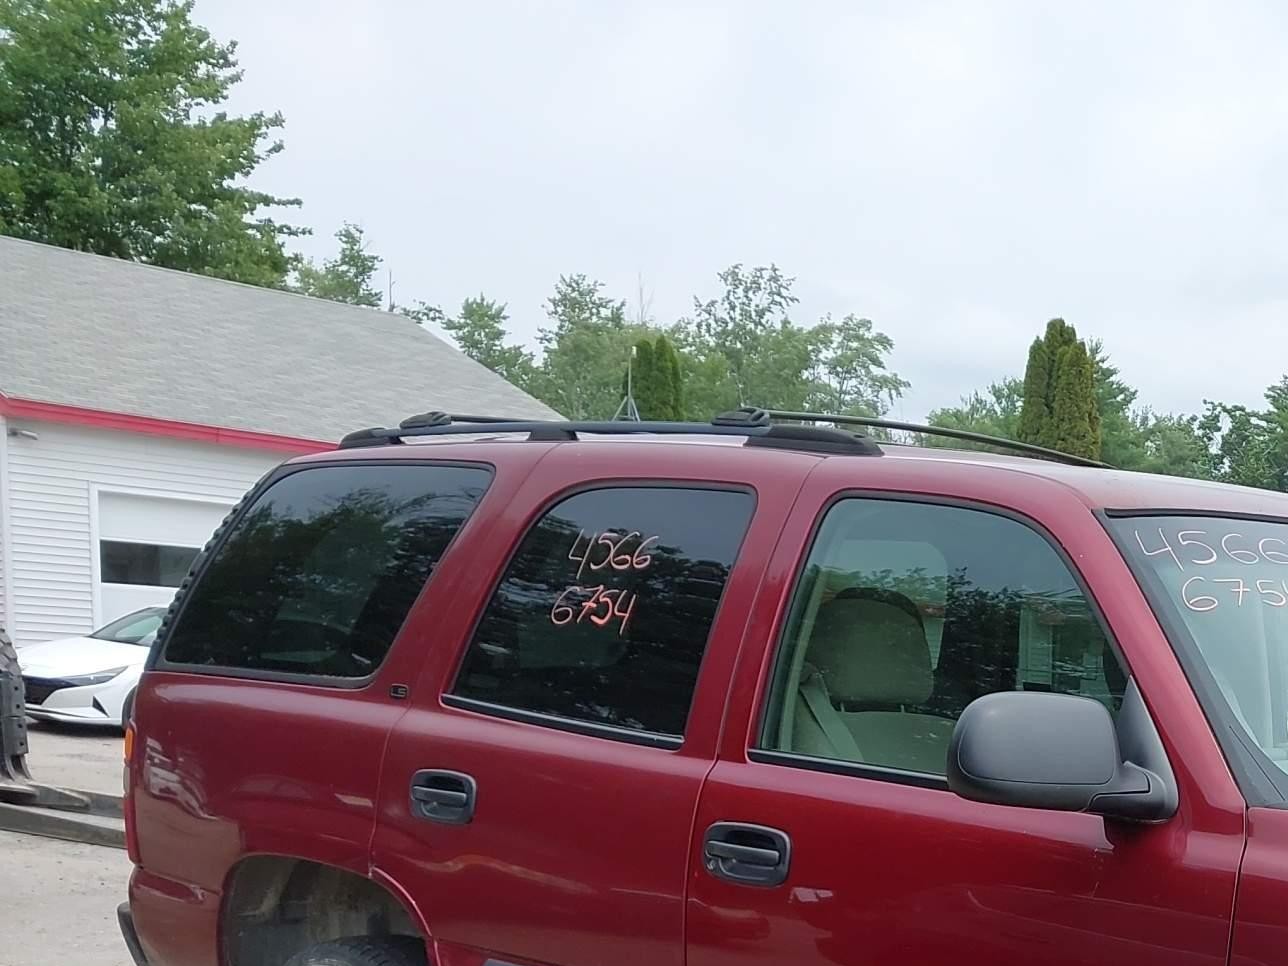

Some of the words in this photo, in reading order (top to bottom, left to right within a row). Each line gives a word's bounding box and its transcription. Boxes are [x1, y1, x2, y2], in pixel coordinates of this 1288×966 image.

[567, 528, 660, 580] 4566
[550, 584, 638, 636] 6754
[390, 687, 407, 698] LS
